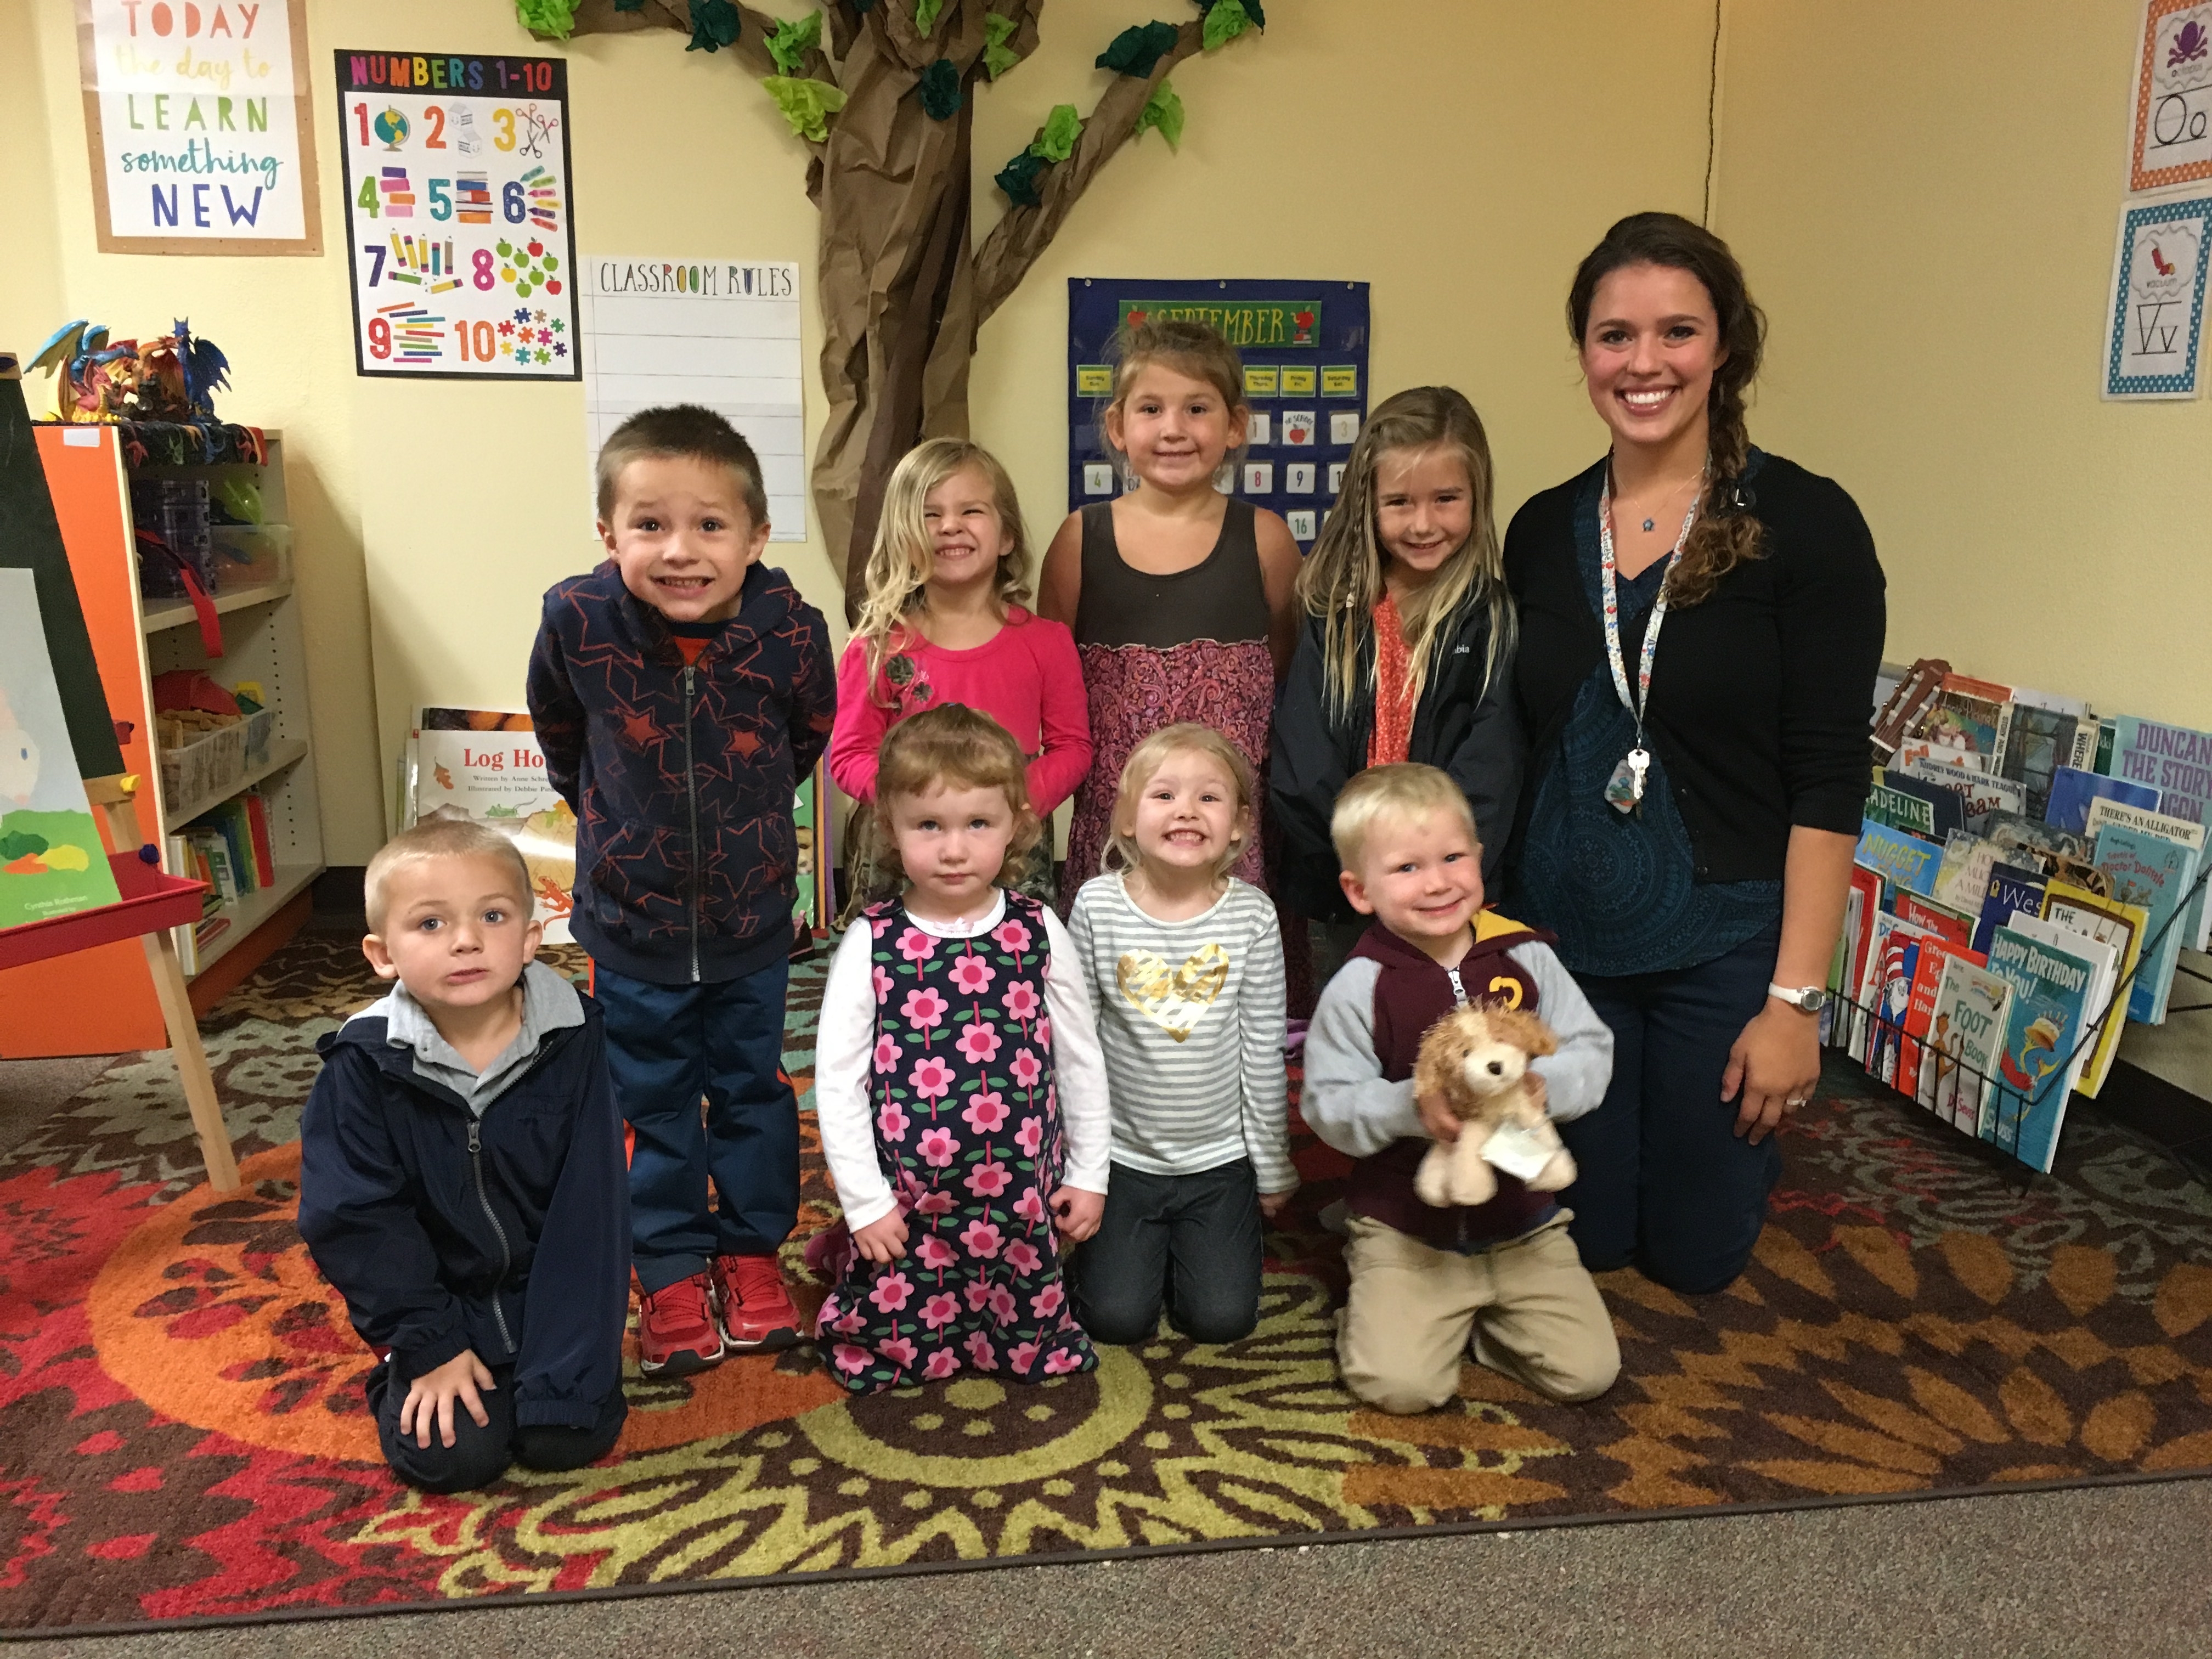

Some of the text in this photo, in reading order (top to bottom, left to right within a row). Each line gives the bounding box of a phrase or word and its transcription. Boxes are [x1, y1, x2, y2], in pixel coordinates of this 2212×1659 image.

[121, 1, 259, 39] TODAY
[115, 43, 272, 90] the day to
[350, 56, 552, 92] NUMBERS 1-10
[127, 93, 267, 133] LEARN
[354, 103, 370, 146] 1
[424, 106, 447, 149] 2
[492, 108, 516, 152] 3
[121, 137, 284, 190] something
[151, 183, 263, 228] NEW
[358, 176, 380, 218] 4
[428, 178, 452, 222] 5
[502, 181, 526, 224] 6
[364, 245, 386, 287] 7
[471, 249, 494, 291] 8
[601, 262, 792, 296] CLASSROOM RULES
[368, 318, 391, 360] 9
[454, 320, 496, 362] 10
[1341, 420, 1348, 438] 3
[1094, 471, 1102, 488] 4
[1255, 471, 1261, 487] 8
[1296, 470, 1304, 487] 9
[1295, 518, 1308, 534] 16
[464, 748, 504, 771] Log
[1946, 768, 1965, 779] WOOD
[2122, 749, 2158, 784] THE
[1866, 788, 1931, 826] ADELINE
[1863, 833, 1932, 876] NUGGET
[2056, 907, 2076, 925] THE
[1994, 933, 2086, 994] HAPPY BIRTHDAY
[1954, 999, 1993, 1039] FOOT
[1964, 1039, 1988, 1069] BOOK
